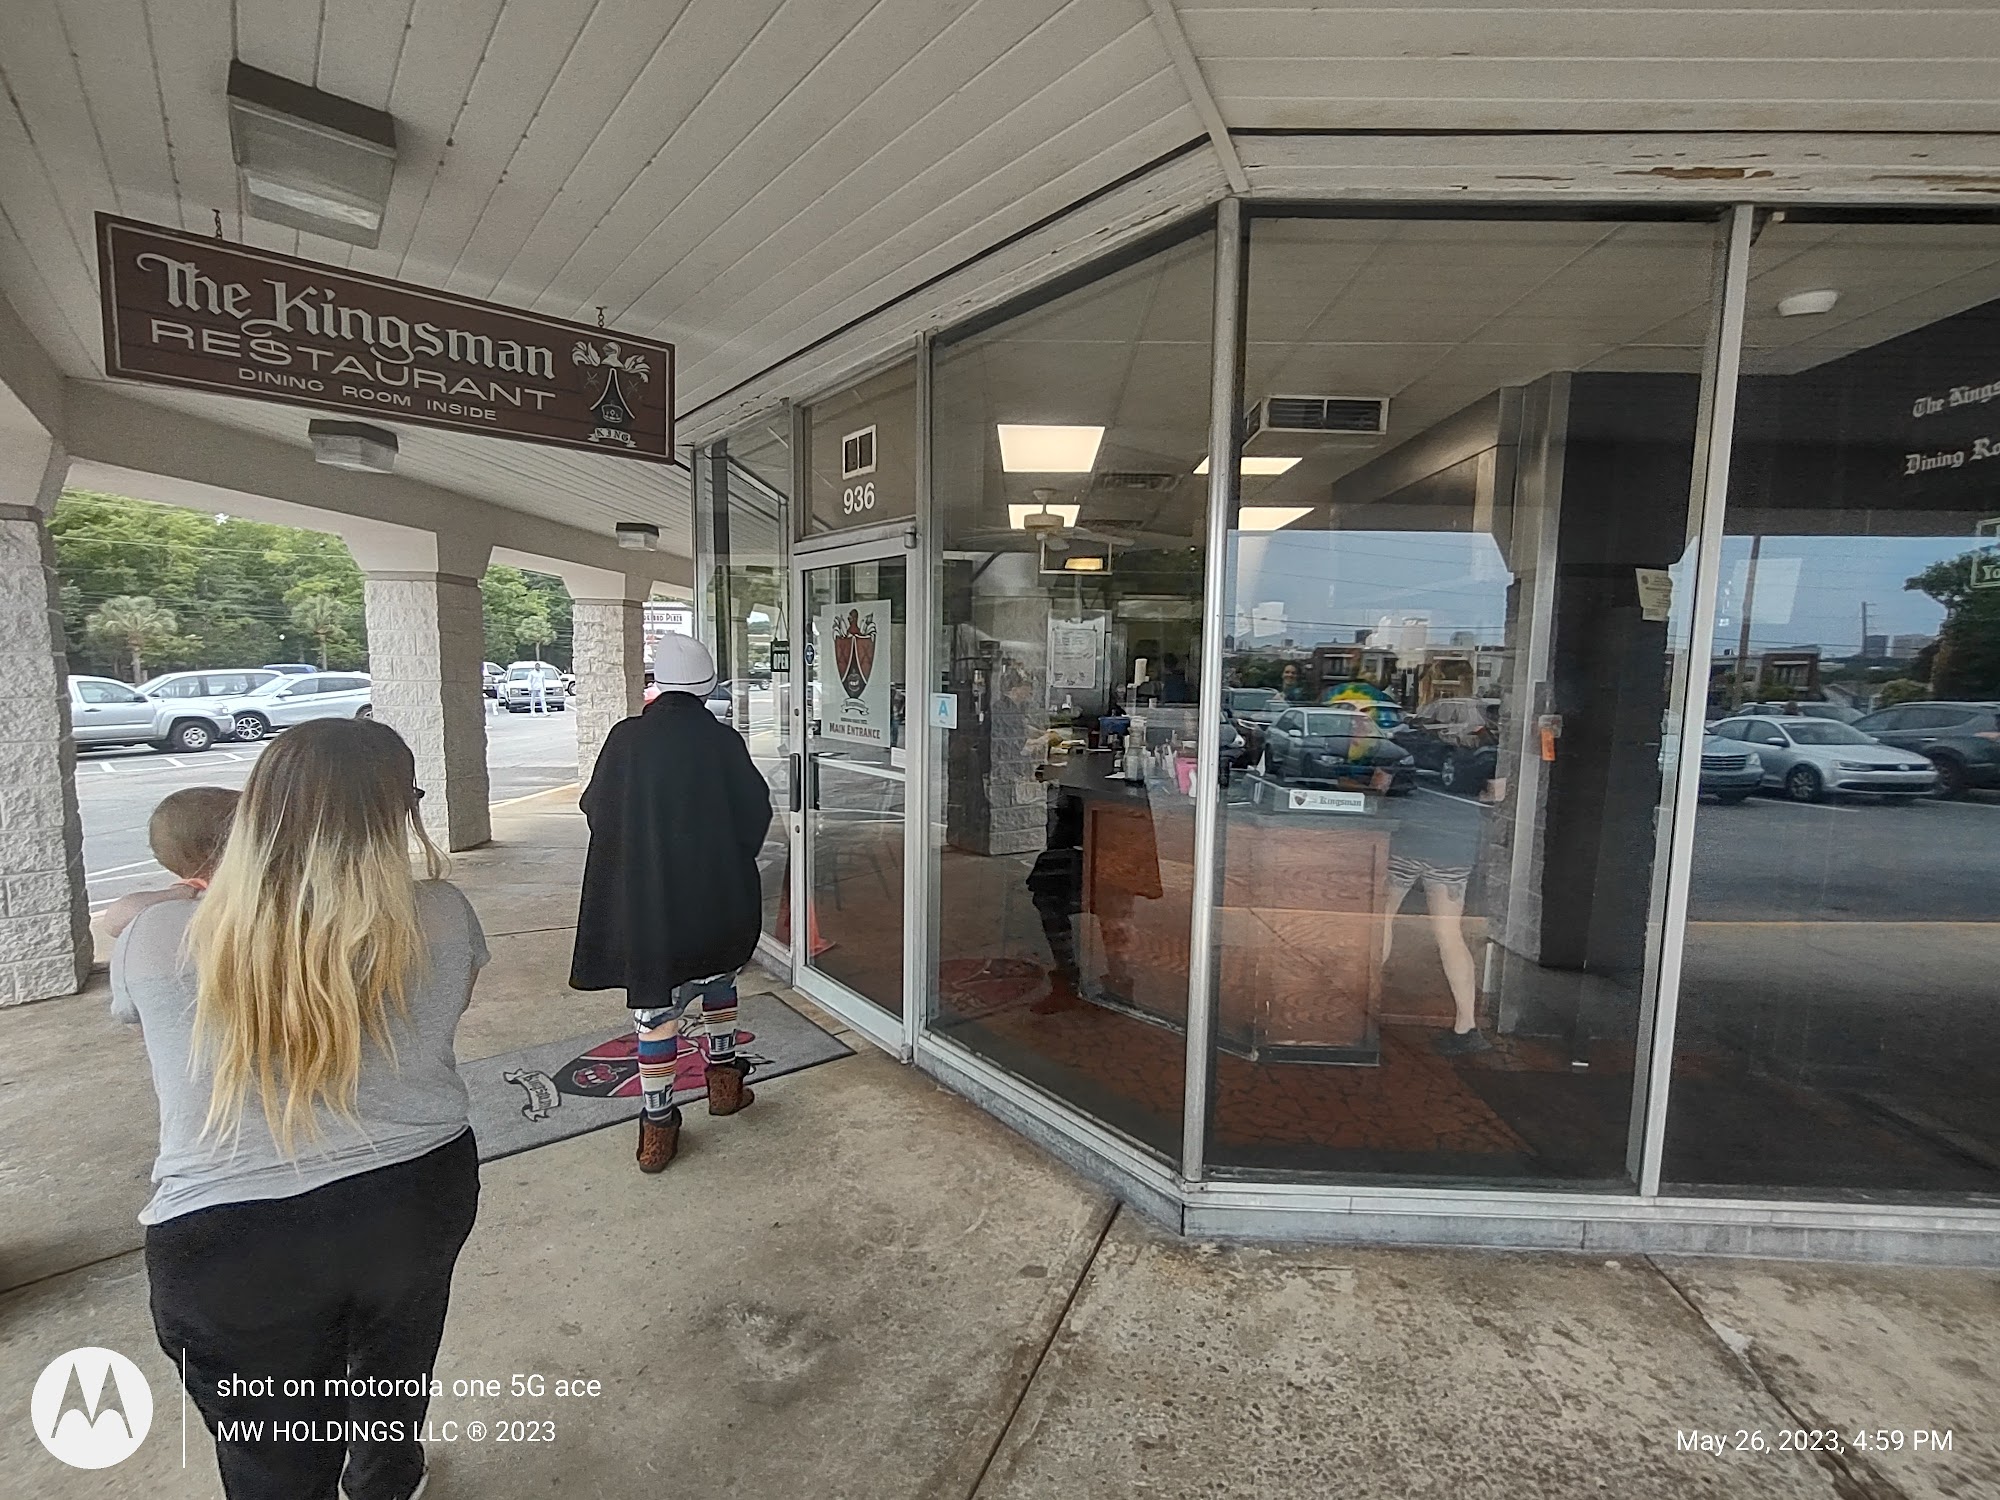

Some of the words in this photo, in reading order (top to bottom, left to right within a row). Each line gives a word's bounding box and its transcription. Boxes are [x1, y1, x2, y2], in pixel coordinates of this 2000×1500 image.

[136, 253, 252, 319] The
[241, 278, 556, 380] Kingsman
[151, 318, 556, 410] RESTAURANT
[238, 367, 325, 392] DINING
[342, 385, 412, 407] ROOM
[426, 399, 497, 421] INSIDE
[1912, 396, 1945, 418] The
[1904, 451, 1964, 475] Dining
[843, 482, 875, 515] 936
[938, 700, 949, 717] A
[829, 722, 846, 734] MAIN
[847, 724, 881, 740] ENTRANCE
